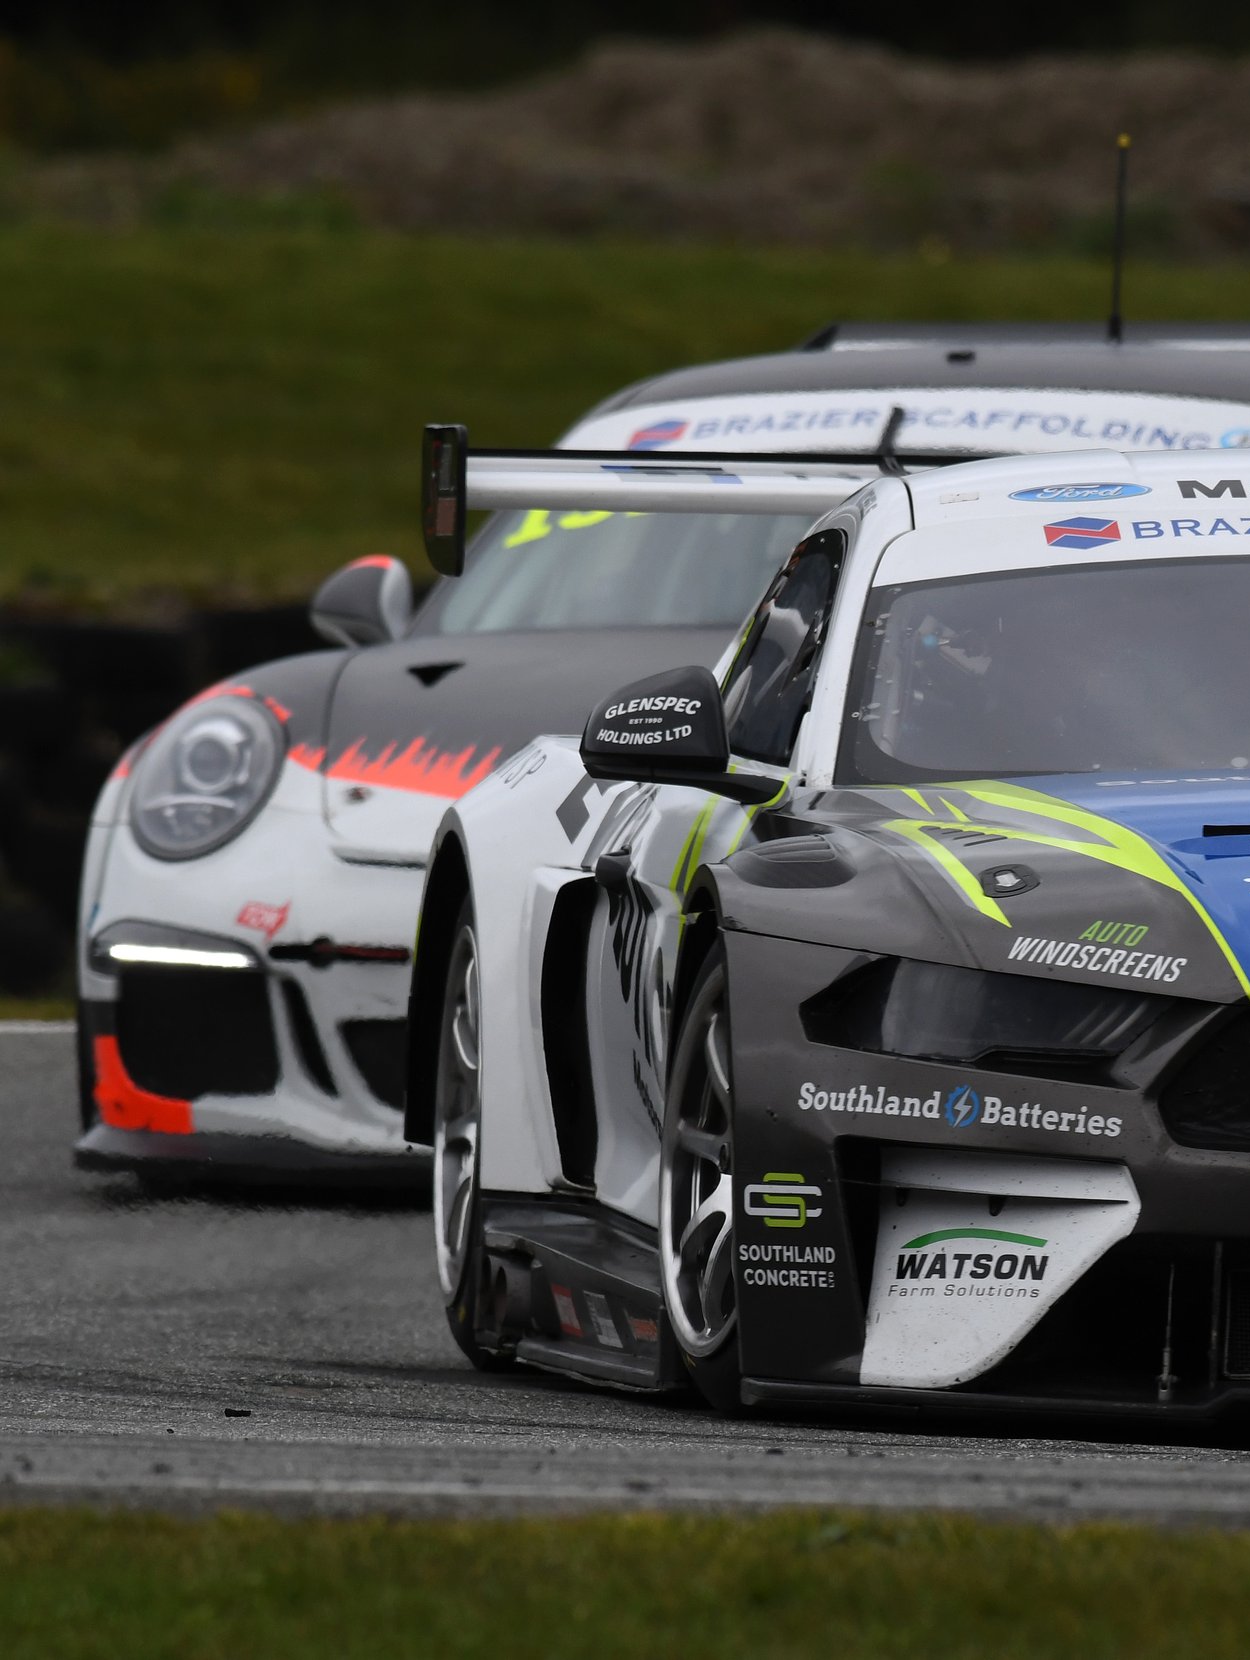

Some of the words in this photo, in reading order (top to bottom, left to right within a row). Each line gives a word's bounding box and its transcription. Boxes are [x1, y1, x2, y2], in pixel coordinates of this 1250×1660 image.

[692, 408, 879, 439] BRAZIER
[1037, 484, 1122, 499] Ford
[605, 696, 701, 719] GLENSPEC
[596, 728, 662, 745] HOLDINGS
[665, 725, 692, 741] LTD
[1078, 920, 1149, 947] AUTO
[1008, 936, 1188, 982] WINDSCREENS
[798, 1082, 941, 1120] Southland
[980, 1096, 1123, 1137] Batteries
[739, 1244, 835, 1263] SOUTHLAND
[744, 1268, 828, 1287] CONCRETE
[896, 1253, 1049, 1281] WATSON
[888, 1284, 935, 1297] Farm
[944, 1284, 1040, 1298] Solutions
